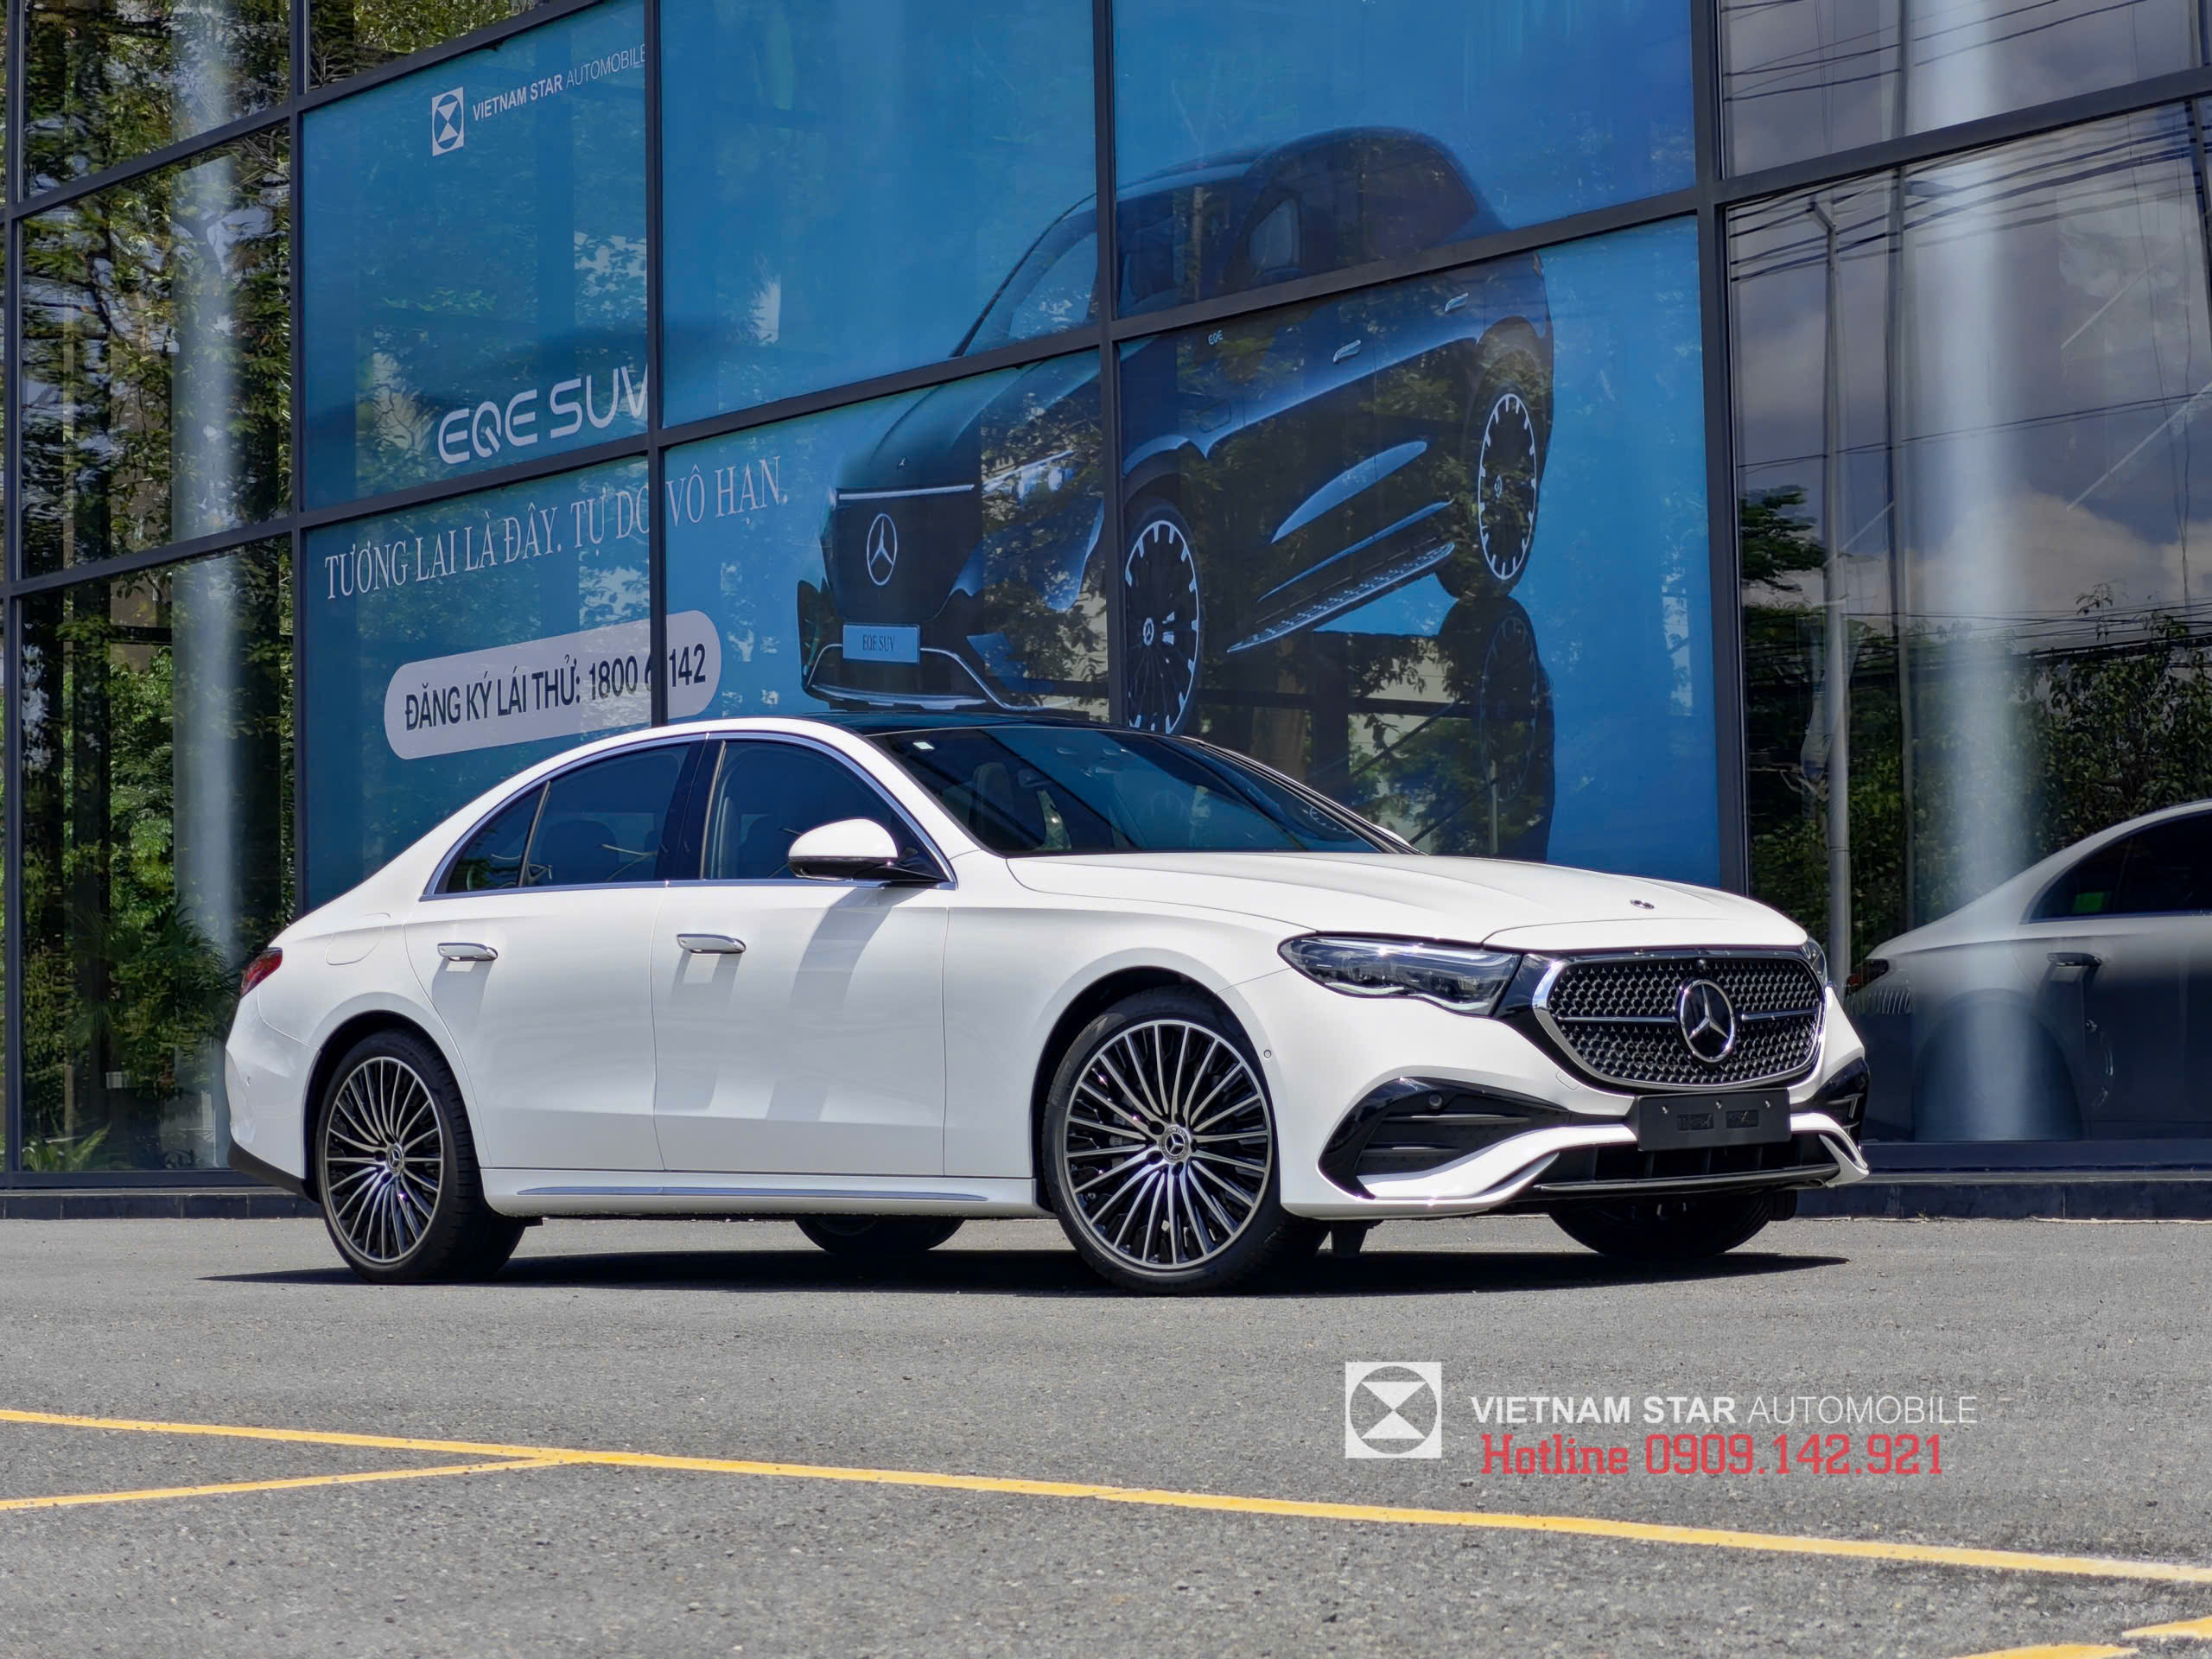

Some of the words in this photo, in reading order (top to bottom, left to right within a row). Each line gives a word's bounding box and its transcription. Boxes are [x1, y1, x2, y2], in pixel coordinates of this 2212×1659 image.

[473, 87, 527, 121] VIETNAM
[530, 74, 563, 101] STAR
[565, 43, 645, 89] AUTOMOBILE
[438, 389, 538, 464] EQE
[550, 362, 648, 440] SUV
[325, 540, 408, 600] TƯƠNG
[415, 530, 457, 582] LAI
[464, 511, 499, 572] LÀ
[503, 501, 563, 564] ĐÂY.
[665, 463, 706, 527] VÔ
[714, 455, 789, 525] HẠN.
[405, 682, 461, 731] ĐĂNG
[467, 671, 493, 721] KÝ
[497, 665, 527, 716] LÁI
[531, 654, 581, 710] THỬ:
[588, 655, 639, 701] 1800
